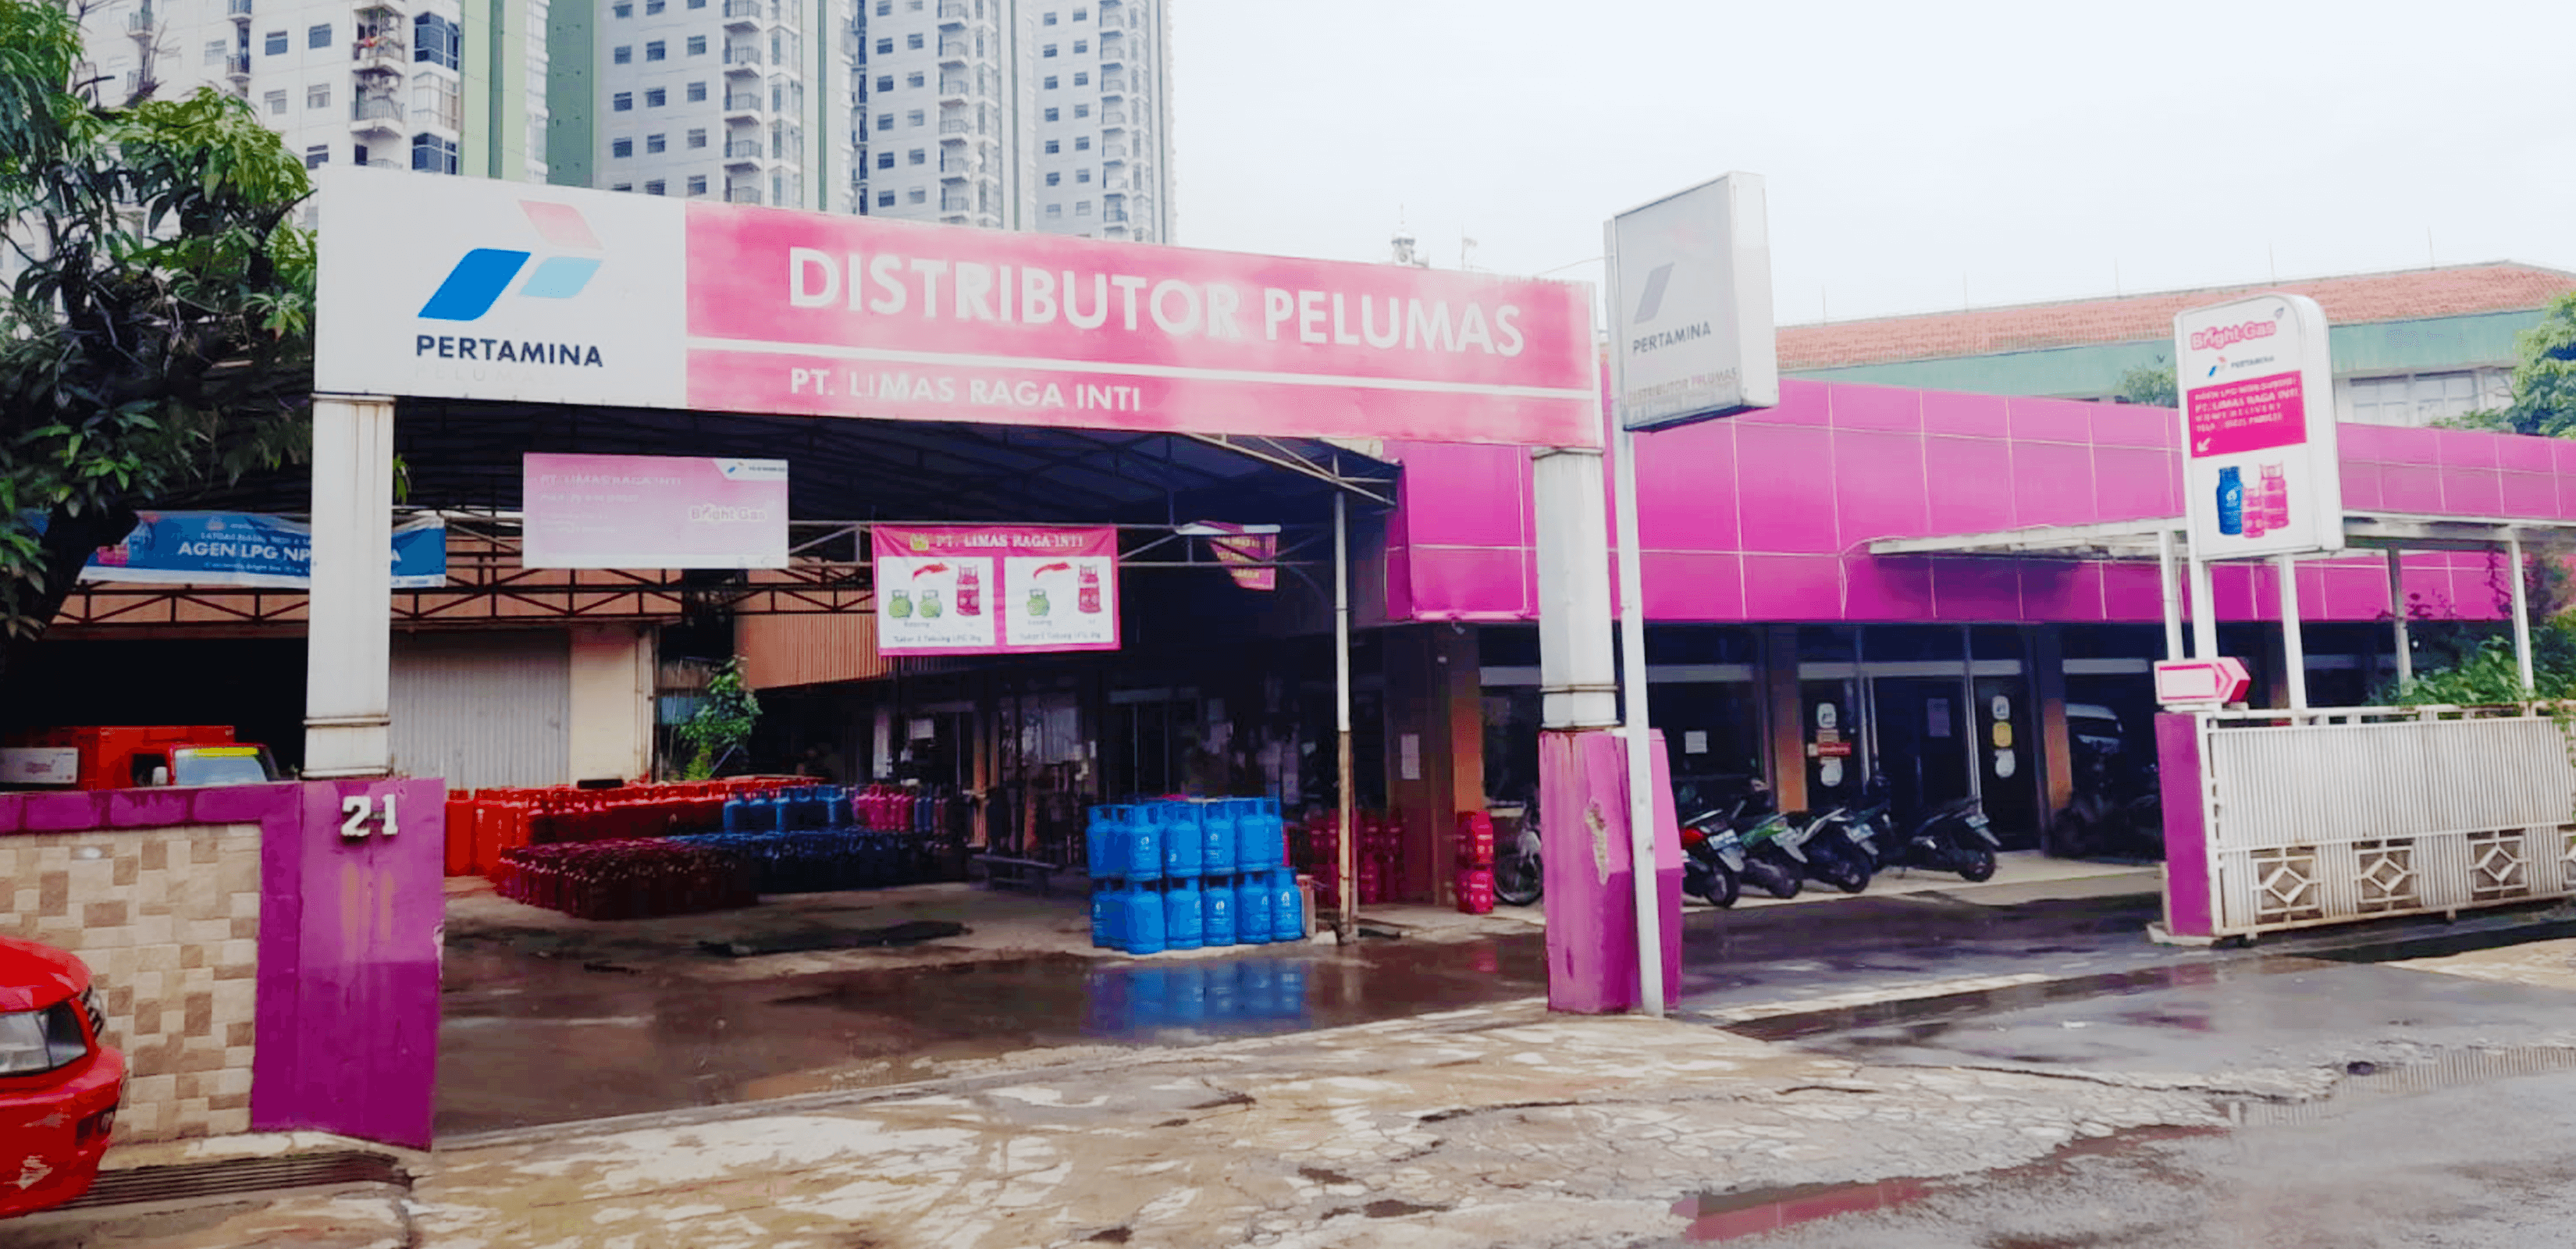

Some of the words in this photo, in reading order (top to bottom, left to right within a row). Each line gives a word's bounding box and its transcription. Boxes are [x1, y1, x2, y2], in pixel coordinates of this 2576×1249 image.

[789, 247, 1242, 339] DISTRIBUTOR
[1264, 286, 1525, 358] PELUMAS
[416, 334, 603, 367] PERTAMINA
[1632, 321, 1711, 354] PERTAMINA
[791, 367, 834, 397] PT.
[849, 371, 955, 403] LIMAS
[970, 379, 1065, 407] RAGA
[1076, 383, 1140, 411] INTI
[177, 540, 237, 557] AGEN
[240, 545, 279, 560] LPG
[963, 533, 1008, 548] LIMAS
[1012, 534, 1051, 548] RAGA
[340, 793, 399, 838] 21
